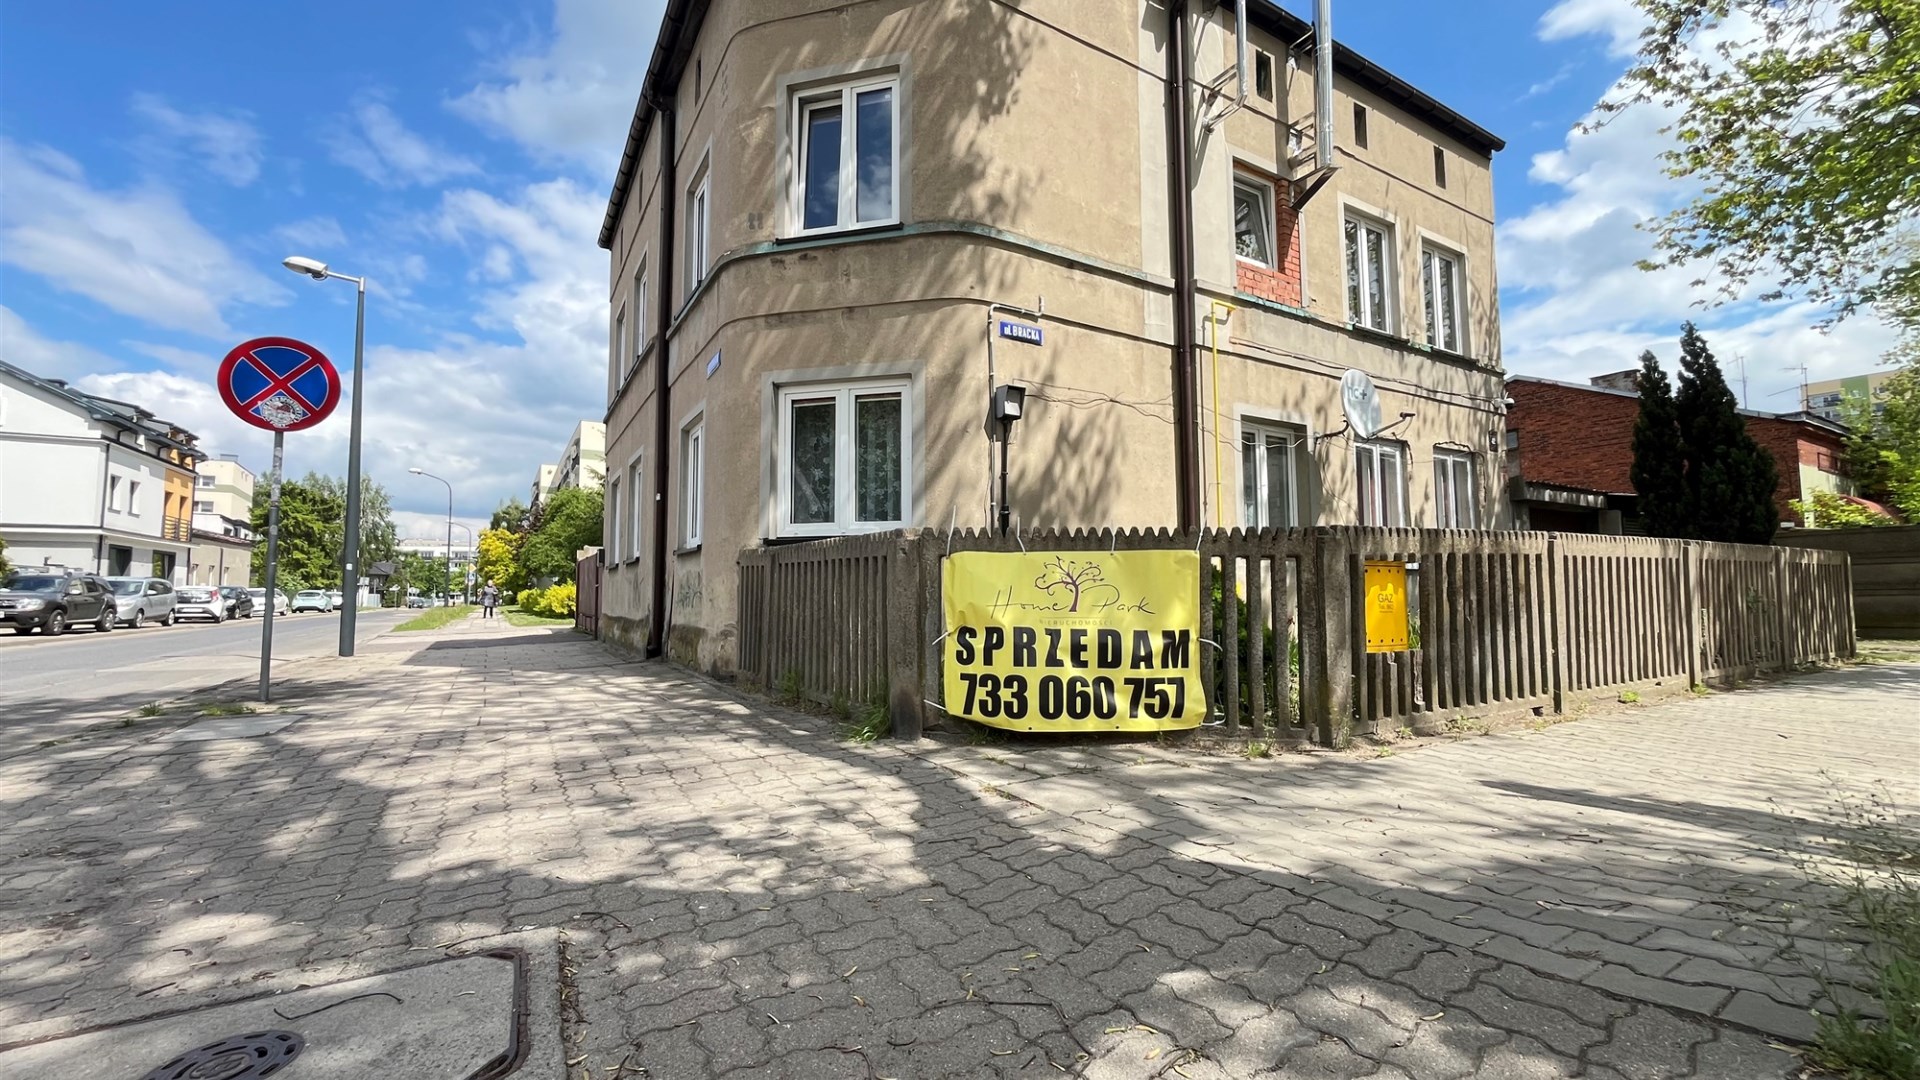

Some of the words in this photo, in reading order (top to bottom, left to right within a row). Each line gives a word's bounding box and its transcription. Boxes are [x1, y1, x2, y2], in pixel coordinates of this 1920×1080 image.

[1012, 325, 1040, 341] BRACKA
[986, 585, 1069, 619] Home
[1081, 584, 1155, 614] Park
[1377, 593, 1393, 603] GAZ
[955, 626, 1190, 670] SPRZEDAM
[960, 673, 1028, 719] 733
[1038, 675, 1116, 720] 060
[1123, 677, 1186, 719] 757
